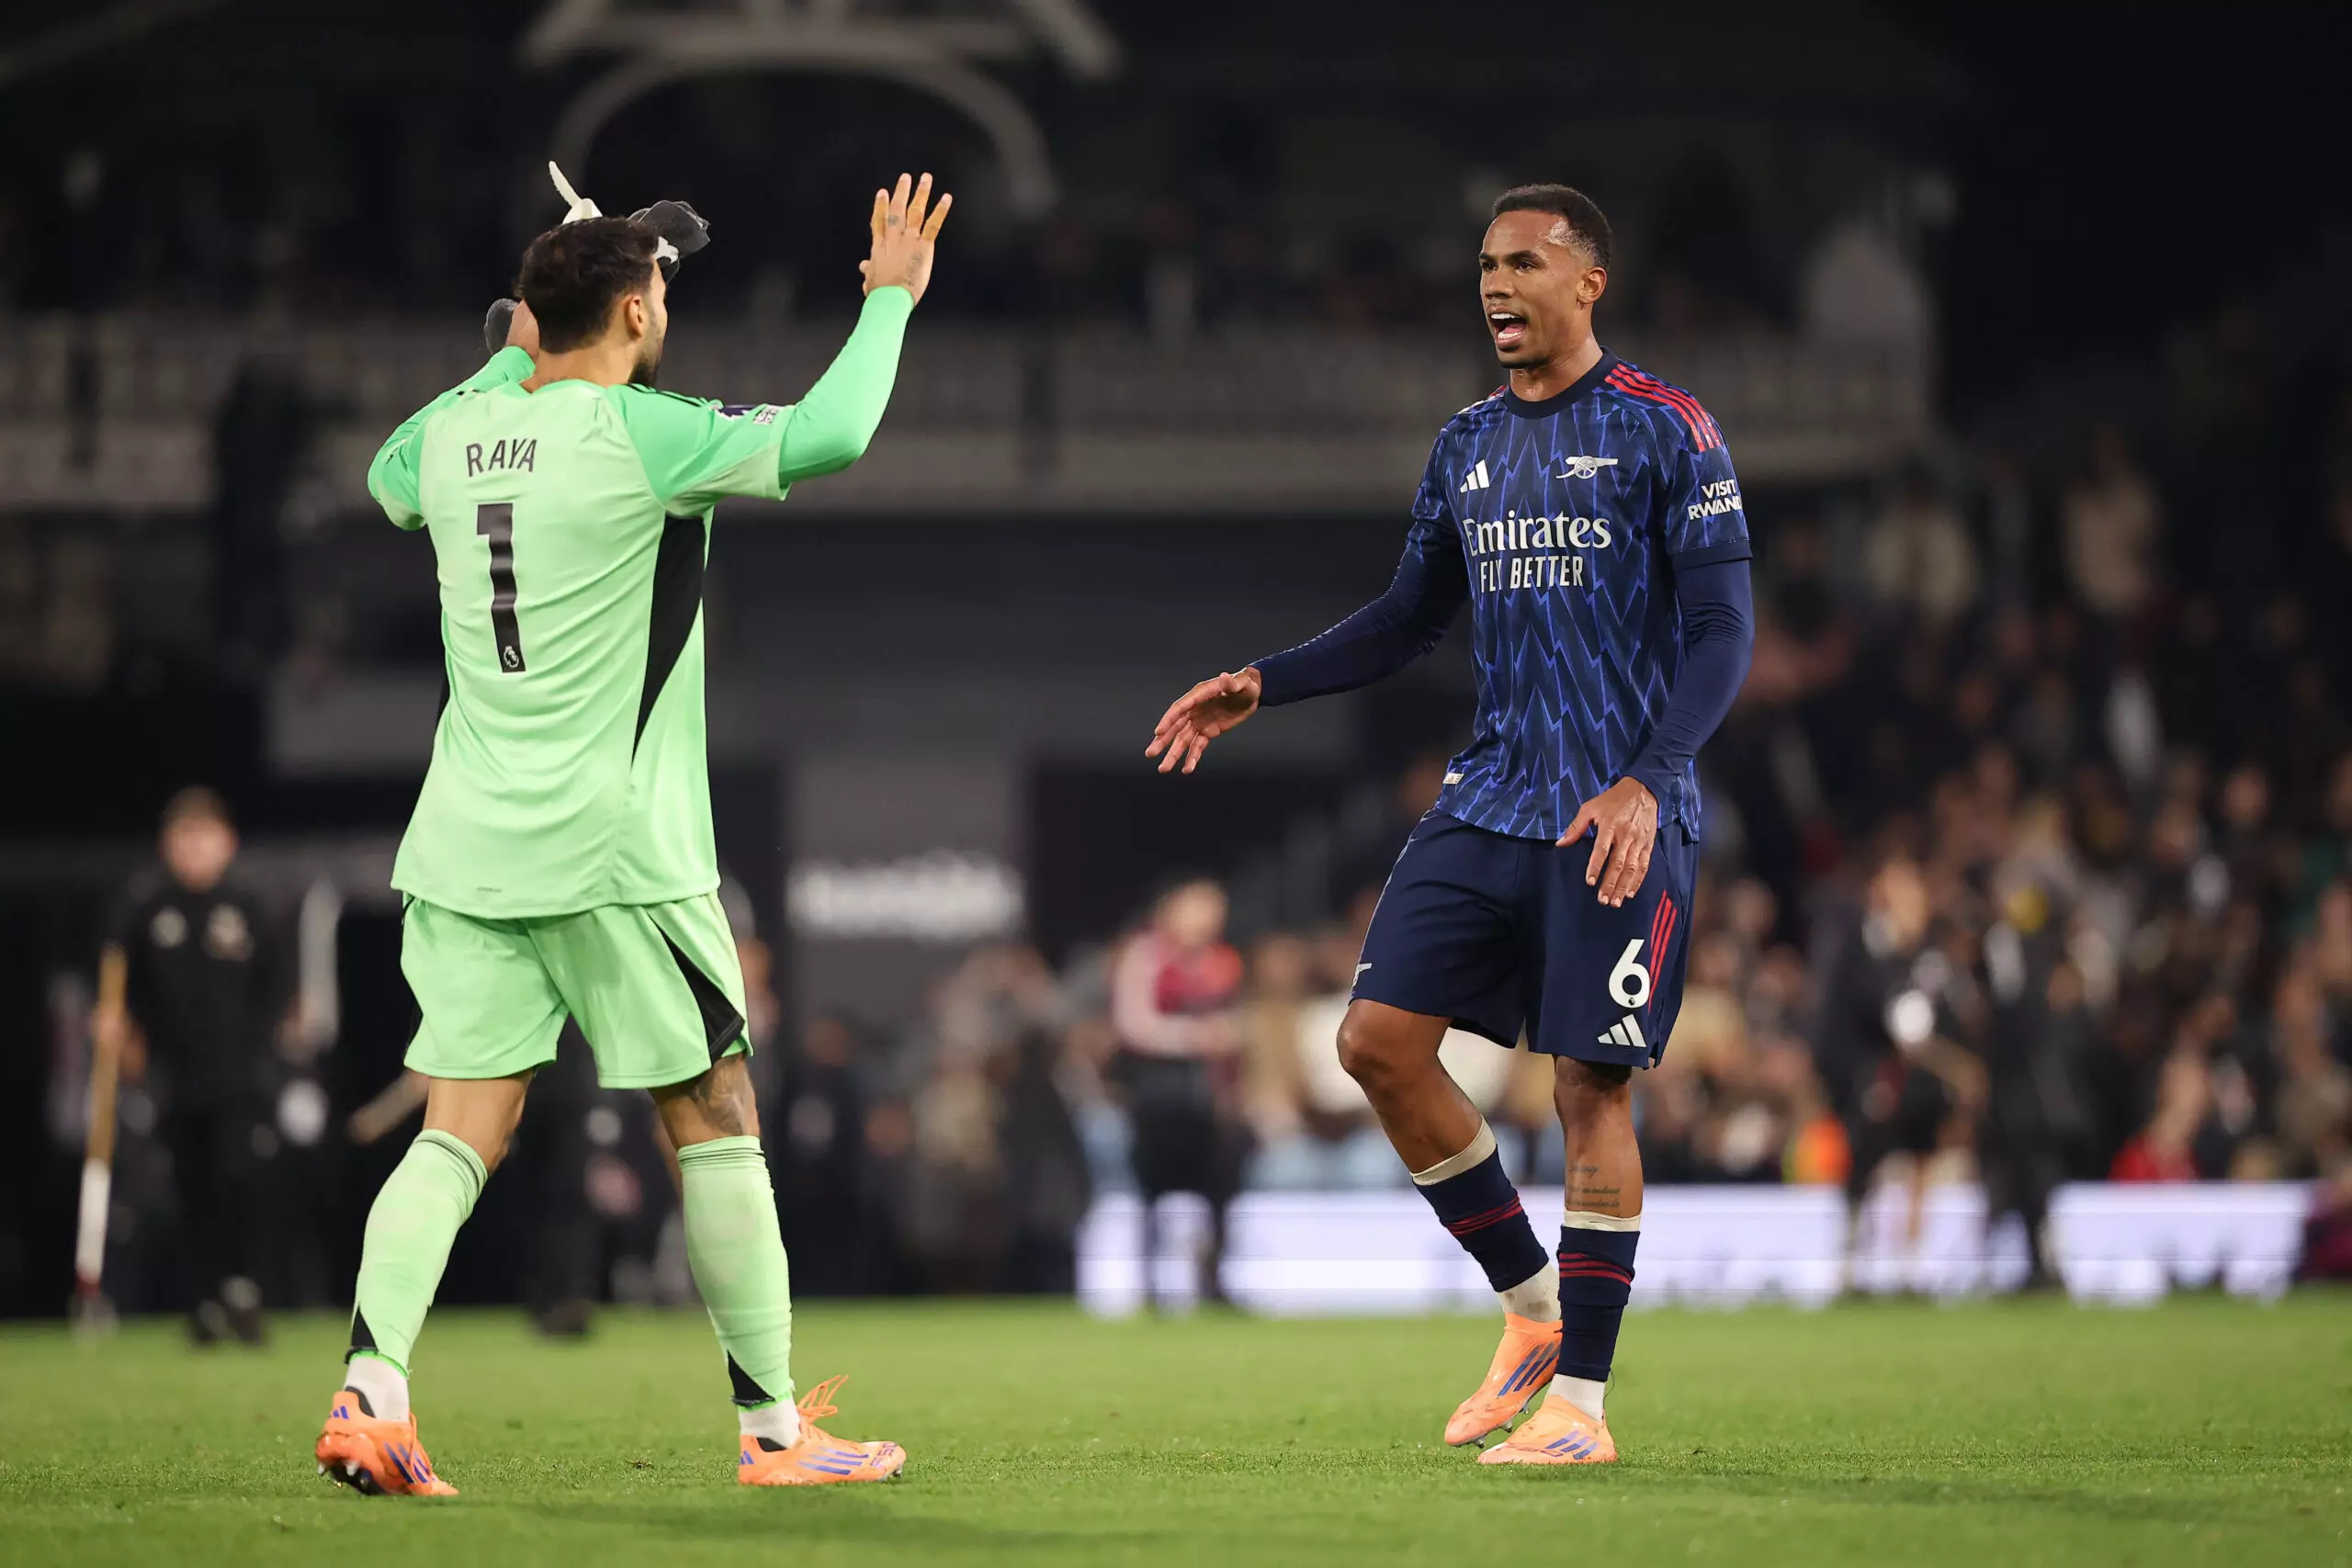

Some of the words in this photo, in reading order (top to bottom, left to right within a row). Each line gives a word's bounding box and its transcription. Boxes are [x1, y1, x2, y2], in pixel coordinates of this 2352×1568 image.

[466, 438, 537, 477] RAYA
[1701, 479, 1736, 499] VISIT
[1462, 509, 1612, 557] Emirates
[476, 502, 526, 673] 1
[1480, 558, 1503, 593] FLY
[1510, 555, 1584, 590] BETTER
[1608, 938, 1651, 1009] 6
